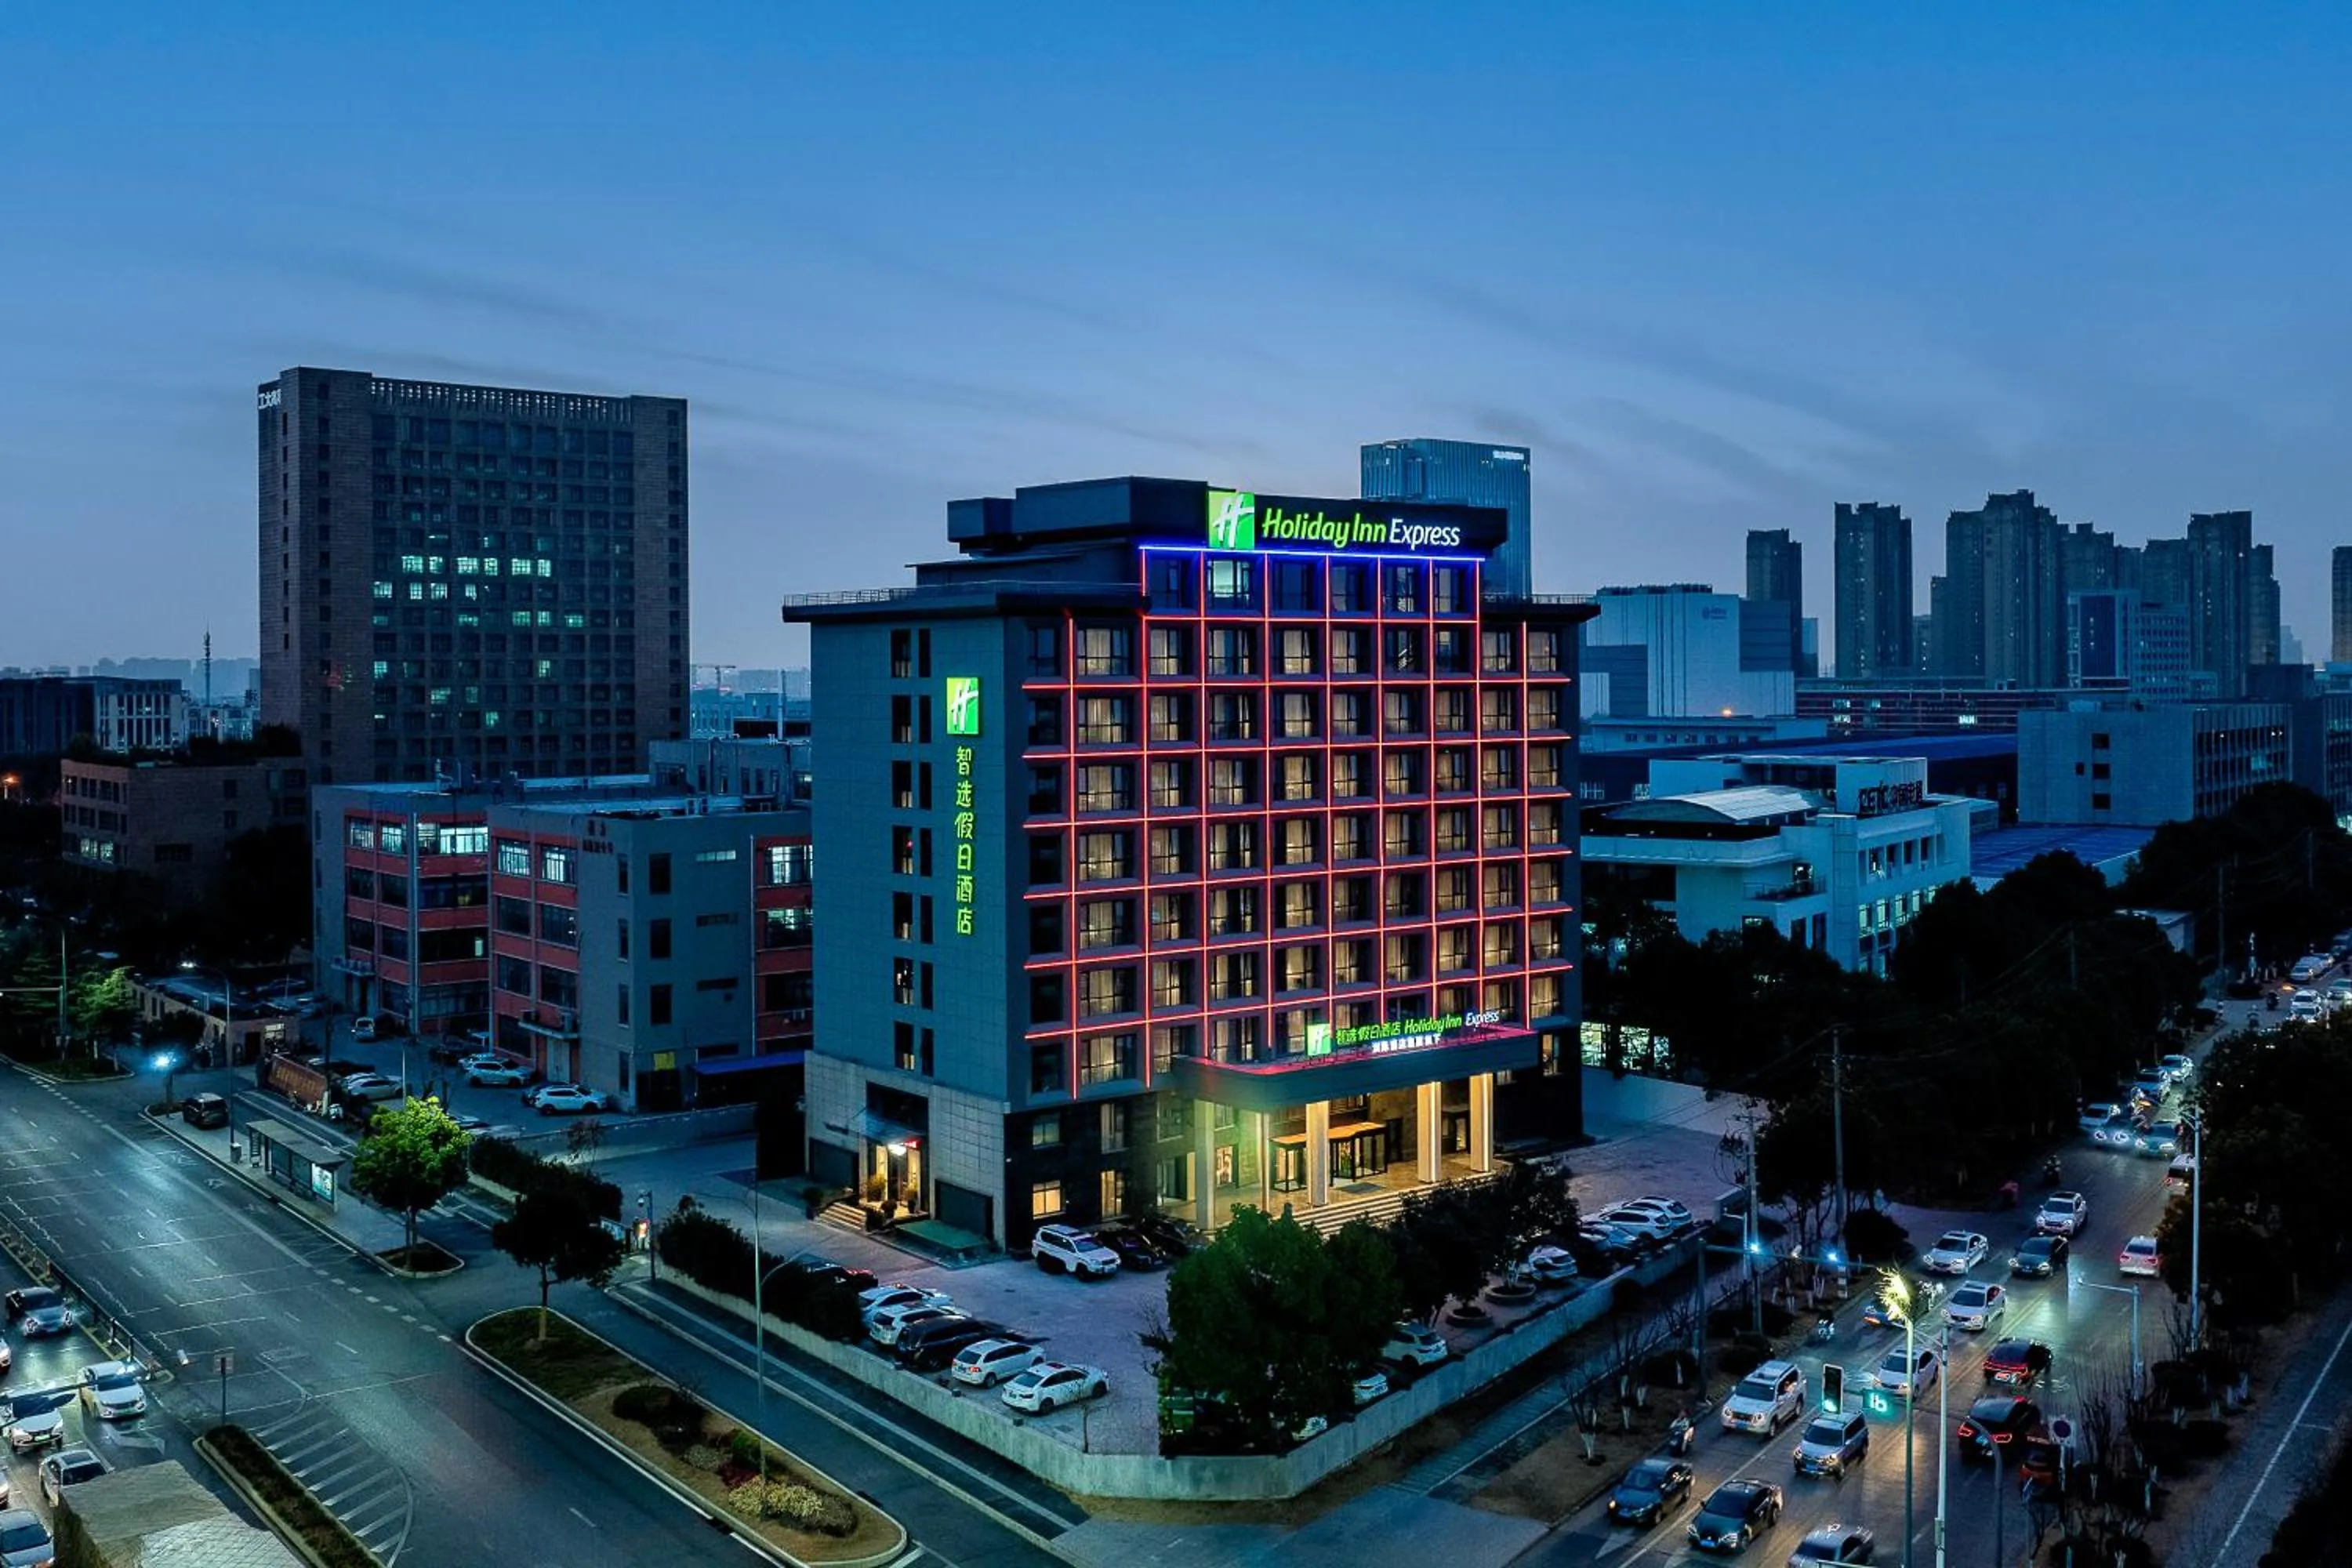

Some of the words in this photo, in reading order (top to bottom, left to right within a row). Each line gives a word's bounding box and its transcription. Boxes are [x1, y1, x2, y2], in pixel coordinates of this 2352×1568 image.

[1262, 507, 1352, 548] Holiday
[1353, 513, 1387, 543] Inn
[1389, 518, 1461, 550] Express
[955, 746, 973, 935] 智选假日酒店
[1405, 1016, 1446, 1034] Holiday
[1444, 1013, 1462, 1029] Inn
[1465, 1011, 1499, 1028] Express
